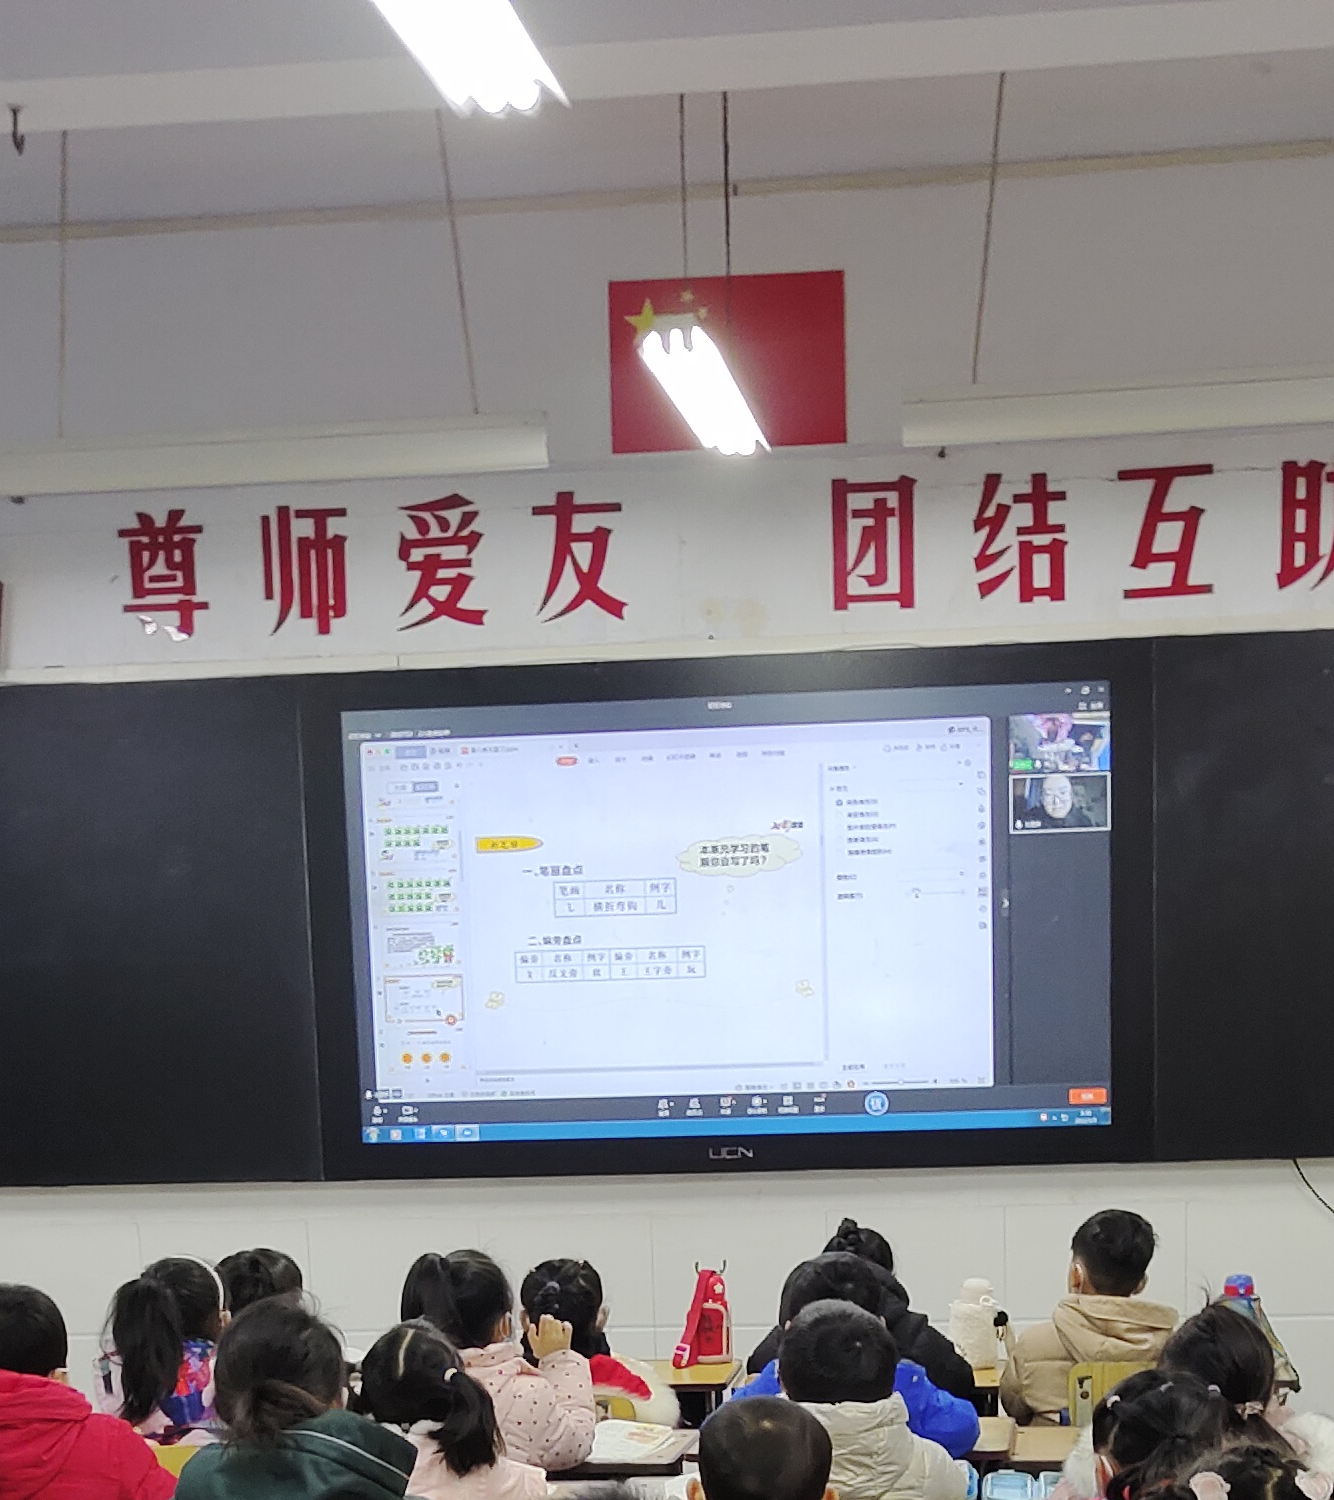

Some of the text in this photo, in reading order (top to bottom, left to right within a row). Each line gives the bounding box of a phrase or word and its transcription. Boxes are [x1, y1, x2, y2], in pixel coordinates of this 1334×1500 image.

[118, 491, 629, 638] 尊师爱友
[709, 1146, 754, 1160] UCN
